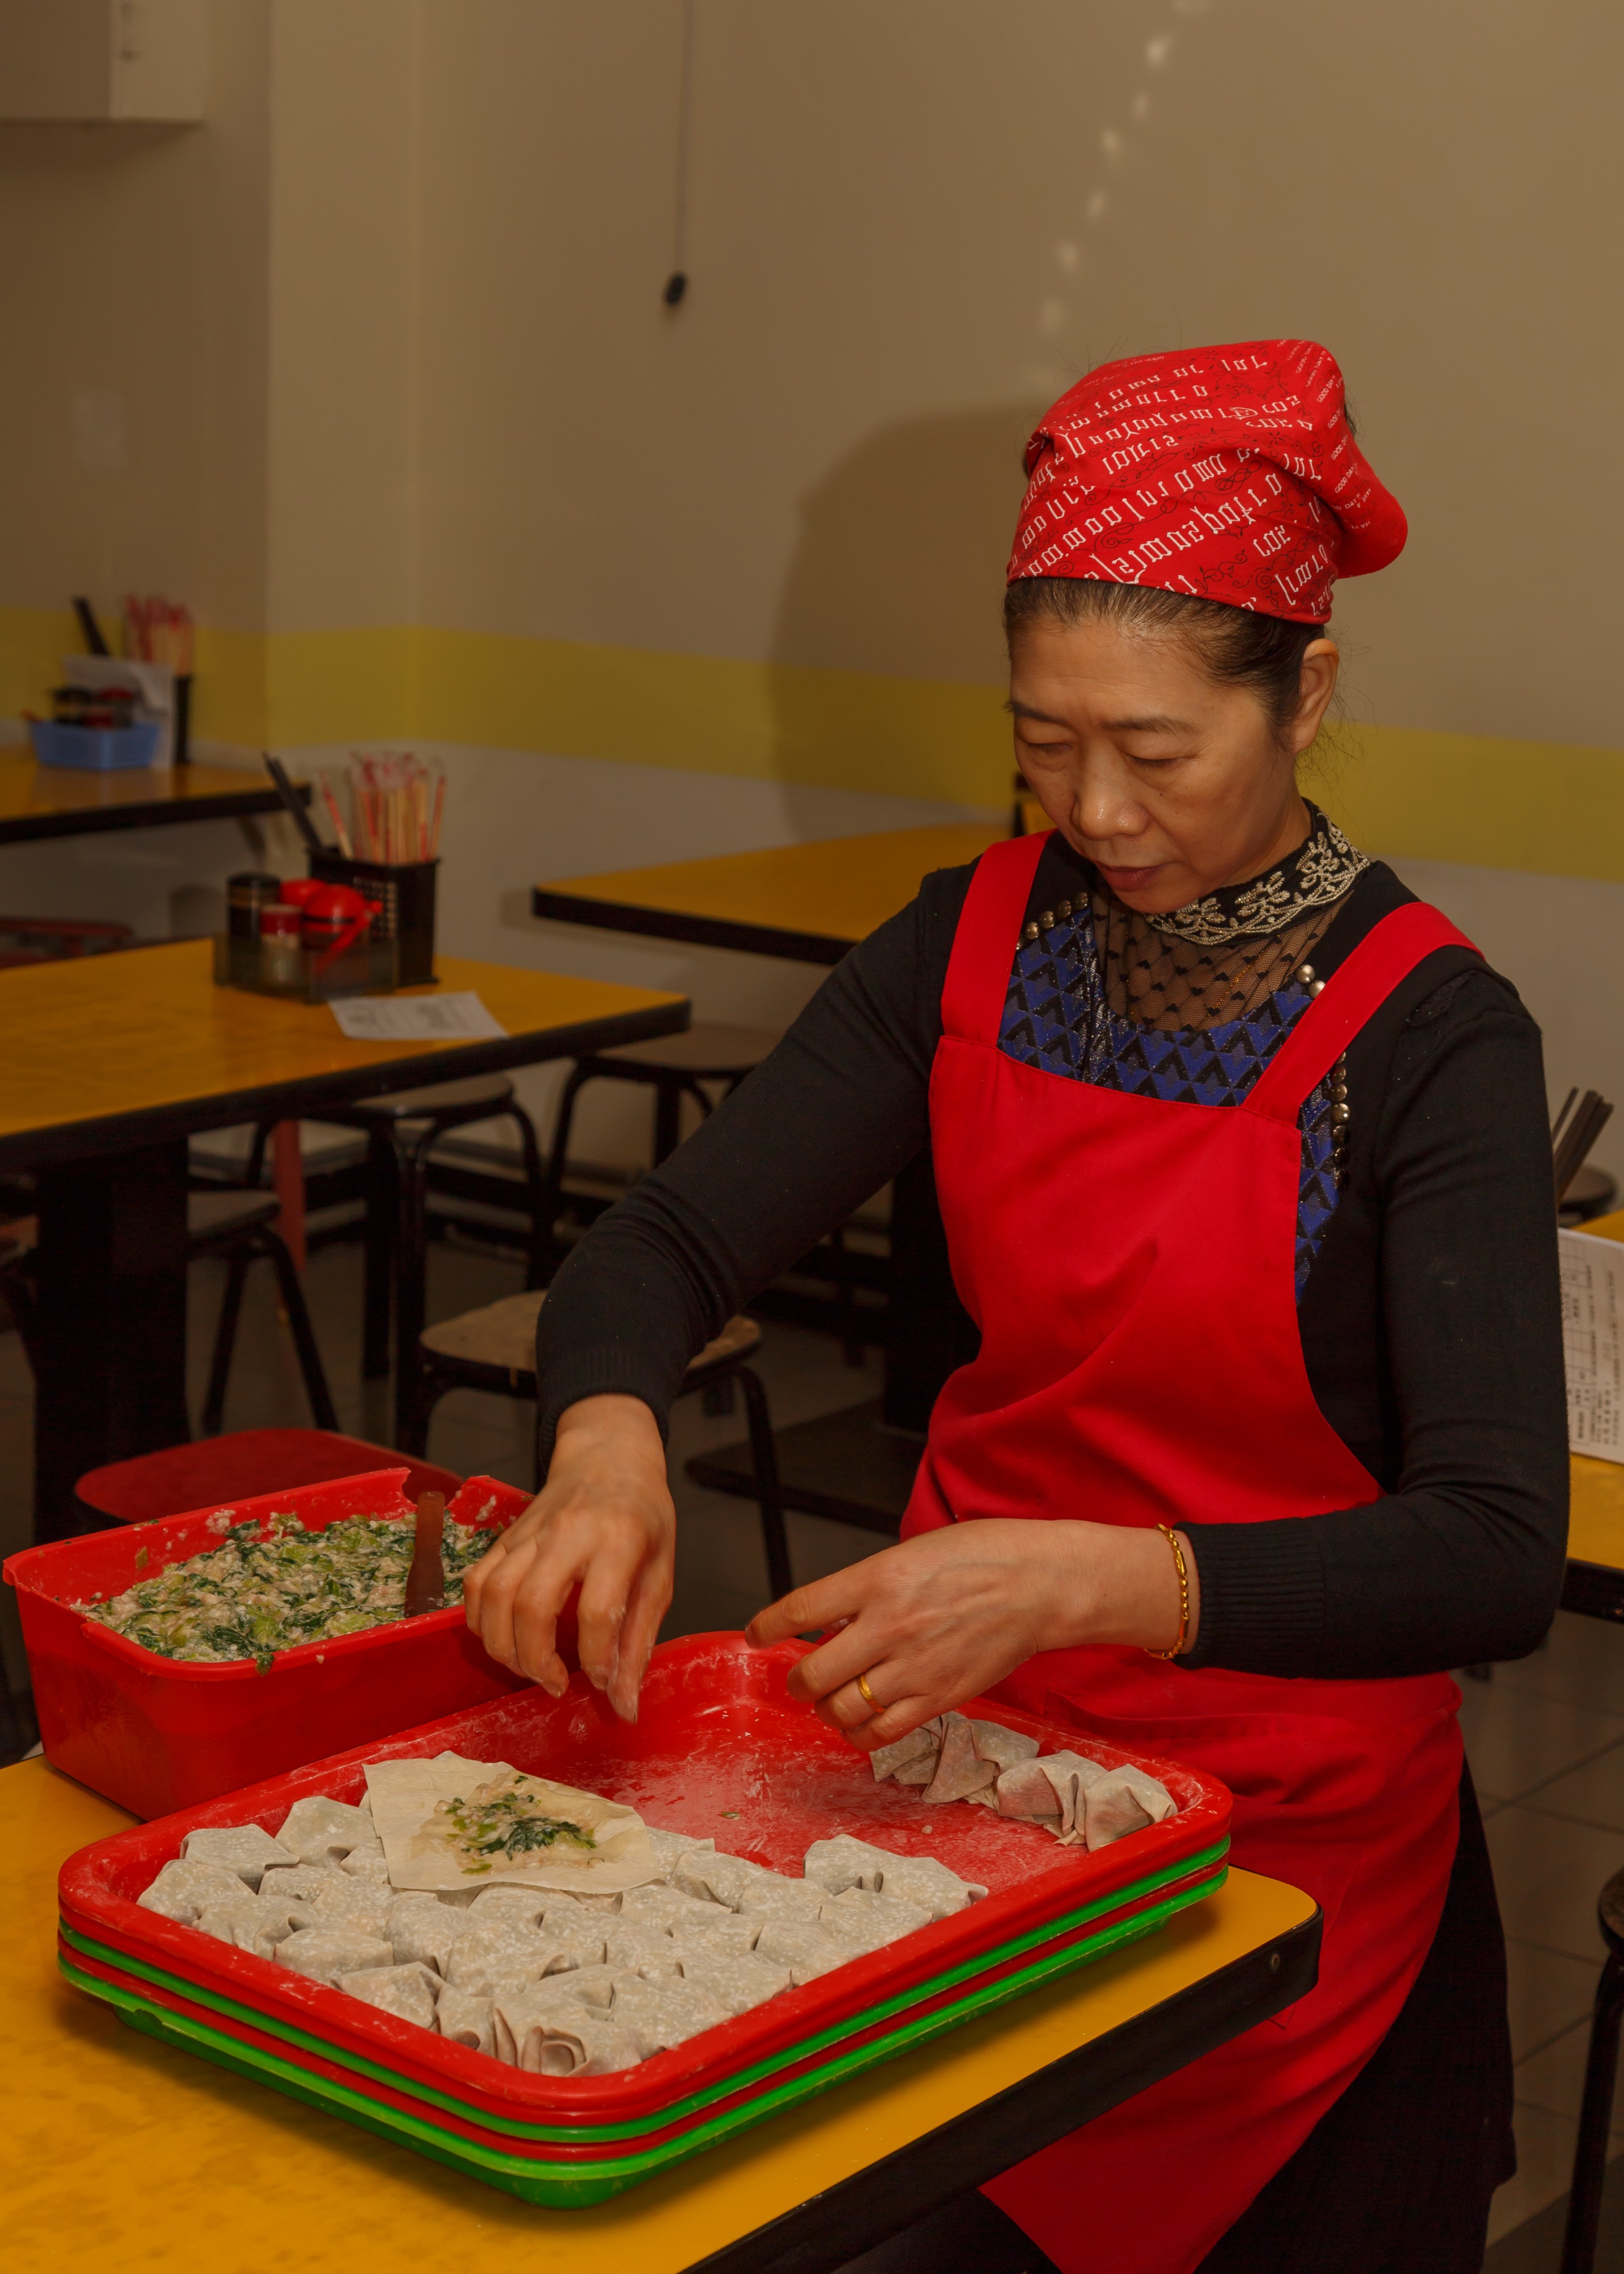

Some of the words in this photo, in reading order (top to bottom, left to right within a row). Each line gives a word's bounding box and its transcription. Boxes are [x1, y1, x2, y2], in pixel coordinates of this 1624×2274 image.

[1316, 388, 1329, 402] GOOD
[1331, 444, 1343, 460] GOOD
[1335, 477, 1348, 493] GOOD
